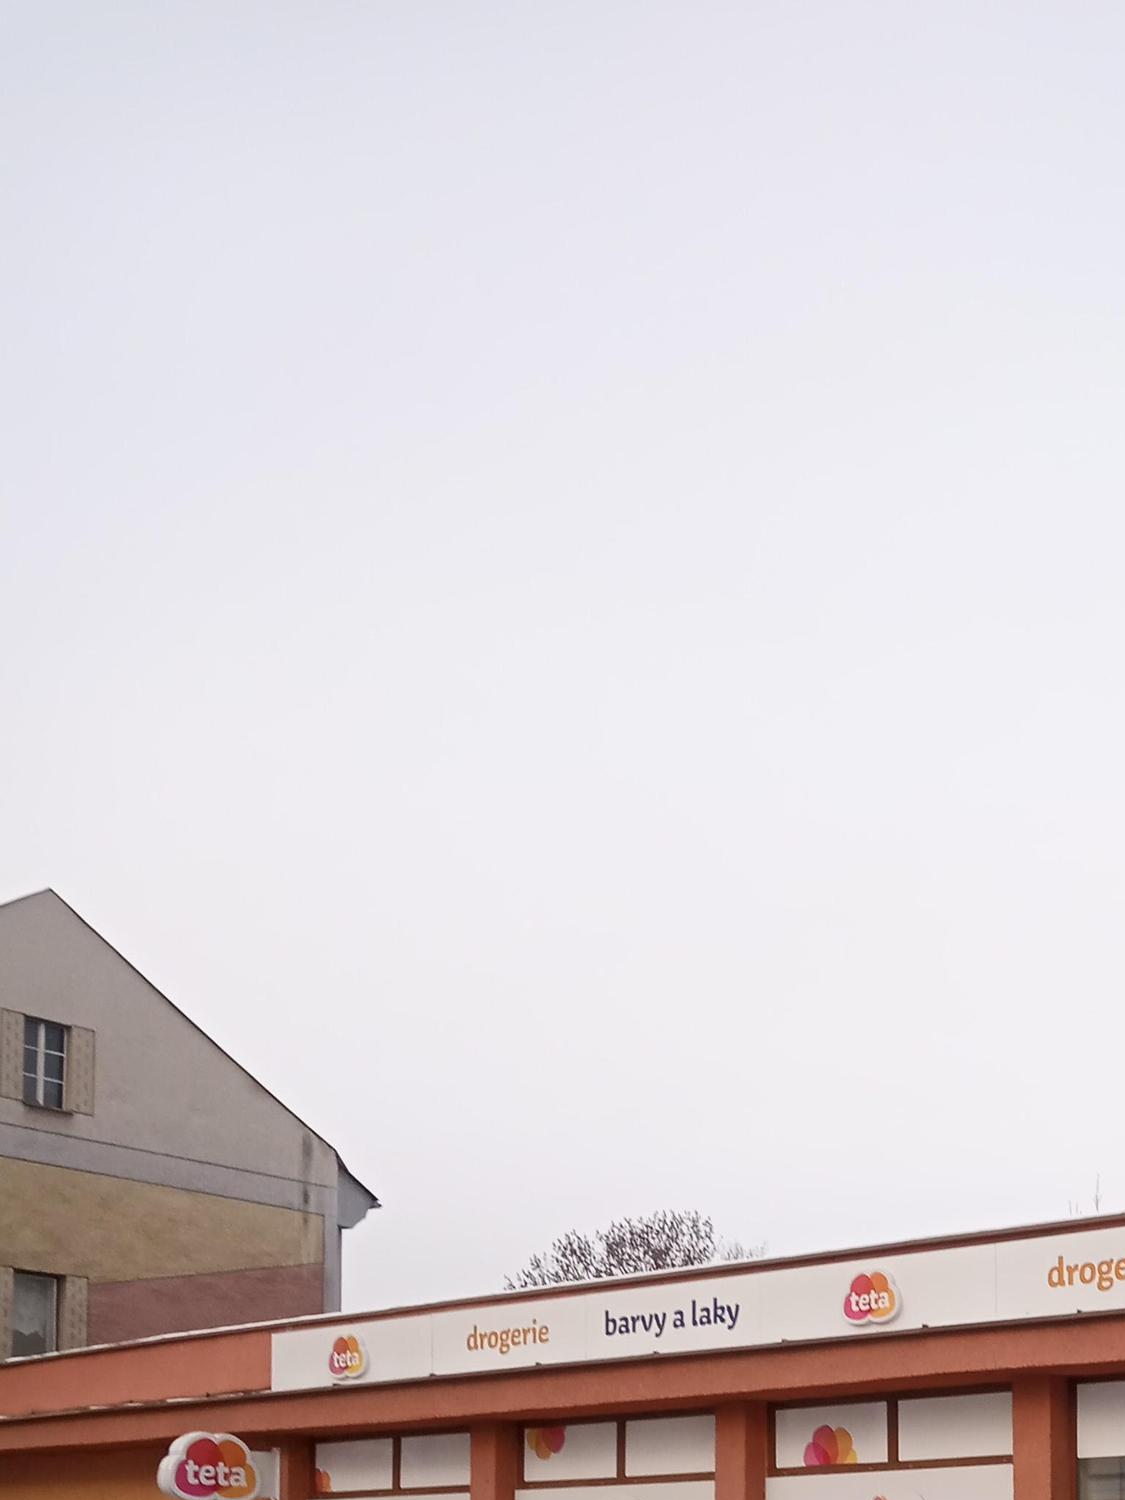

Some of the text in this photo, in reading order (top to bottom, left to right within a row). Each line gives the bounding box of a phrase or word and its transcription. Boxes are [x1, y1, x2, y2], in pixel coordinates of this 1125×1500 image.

[850, 1289, 889, 1312] teta
[604, 1298, 740, 1338] barvy a laky
[467, 1319, 550, 1355] drogerie
[333, 1350, 360, 1368] teta
[185, 1459, 247, 1488] teta
